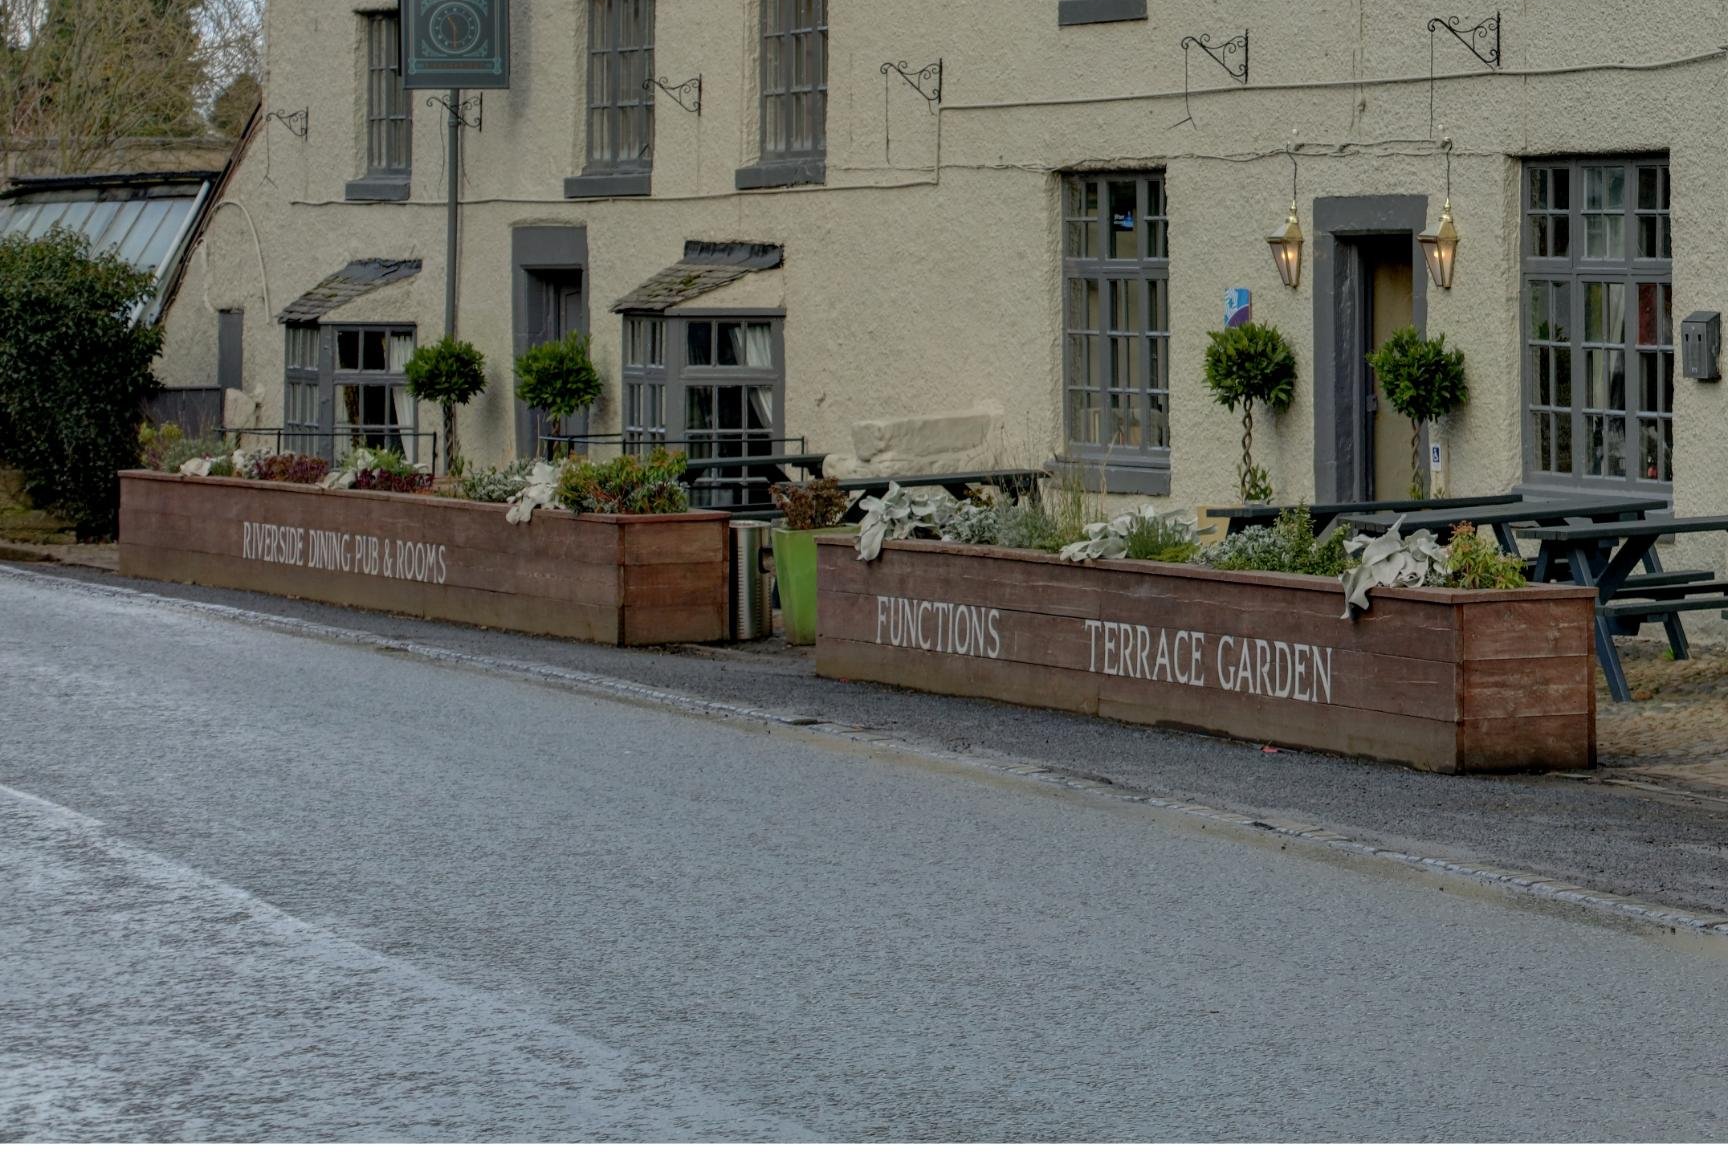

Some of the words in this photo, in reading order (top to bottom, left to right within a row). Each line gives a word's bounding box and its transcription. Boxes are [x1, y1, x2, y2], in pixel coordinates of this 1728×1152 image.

[243, 521, 304, 567] RIVERSIDE
[308, 528, 350, 572] DINING
[354, 534, 379, 576] PUB
[383, 538, 393, 578] &
[396, 539, 446, 584] ROOMS
[876, 595, 1000, 659] FUNCTIONS
[1083, 619, 1205, 687] TERRACE
[1216, 634, 1333, 704] GARDEN
